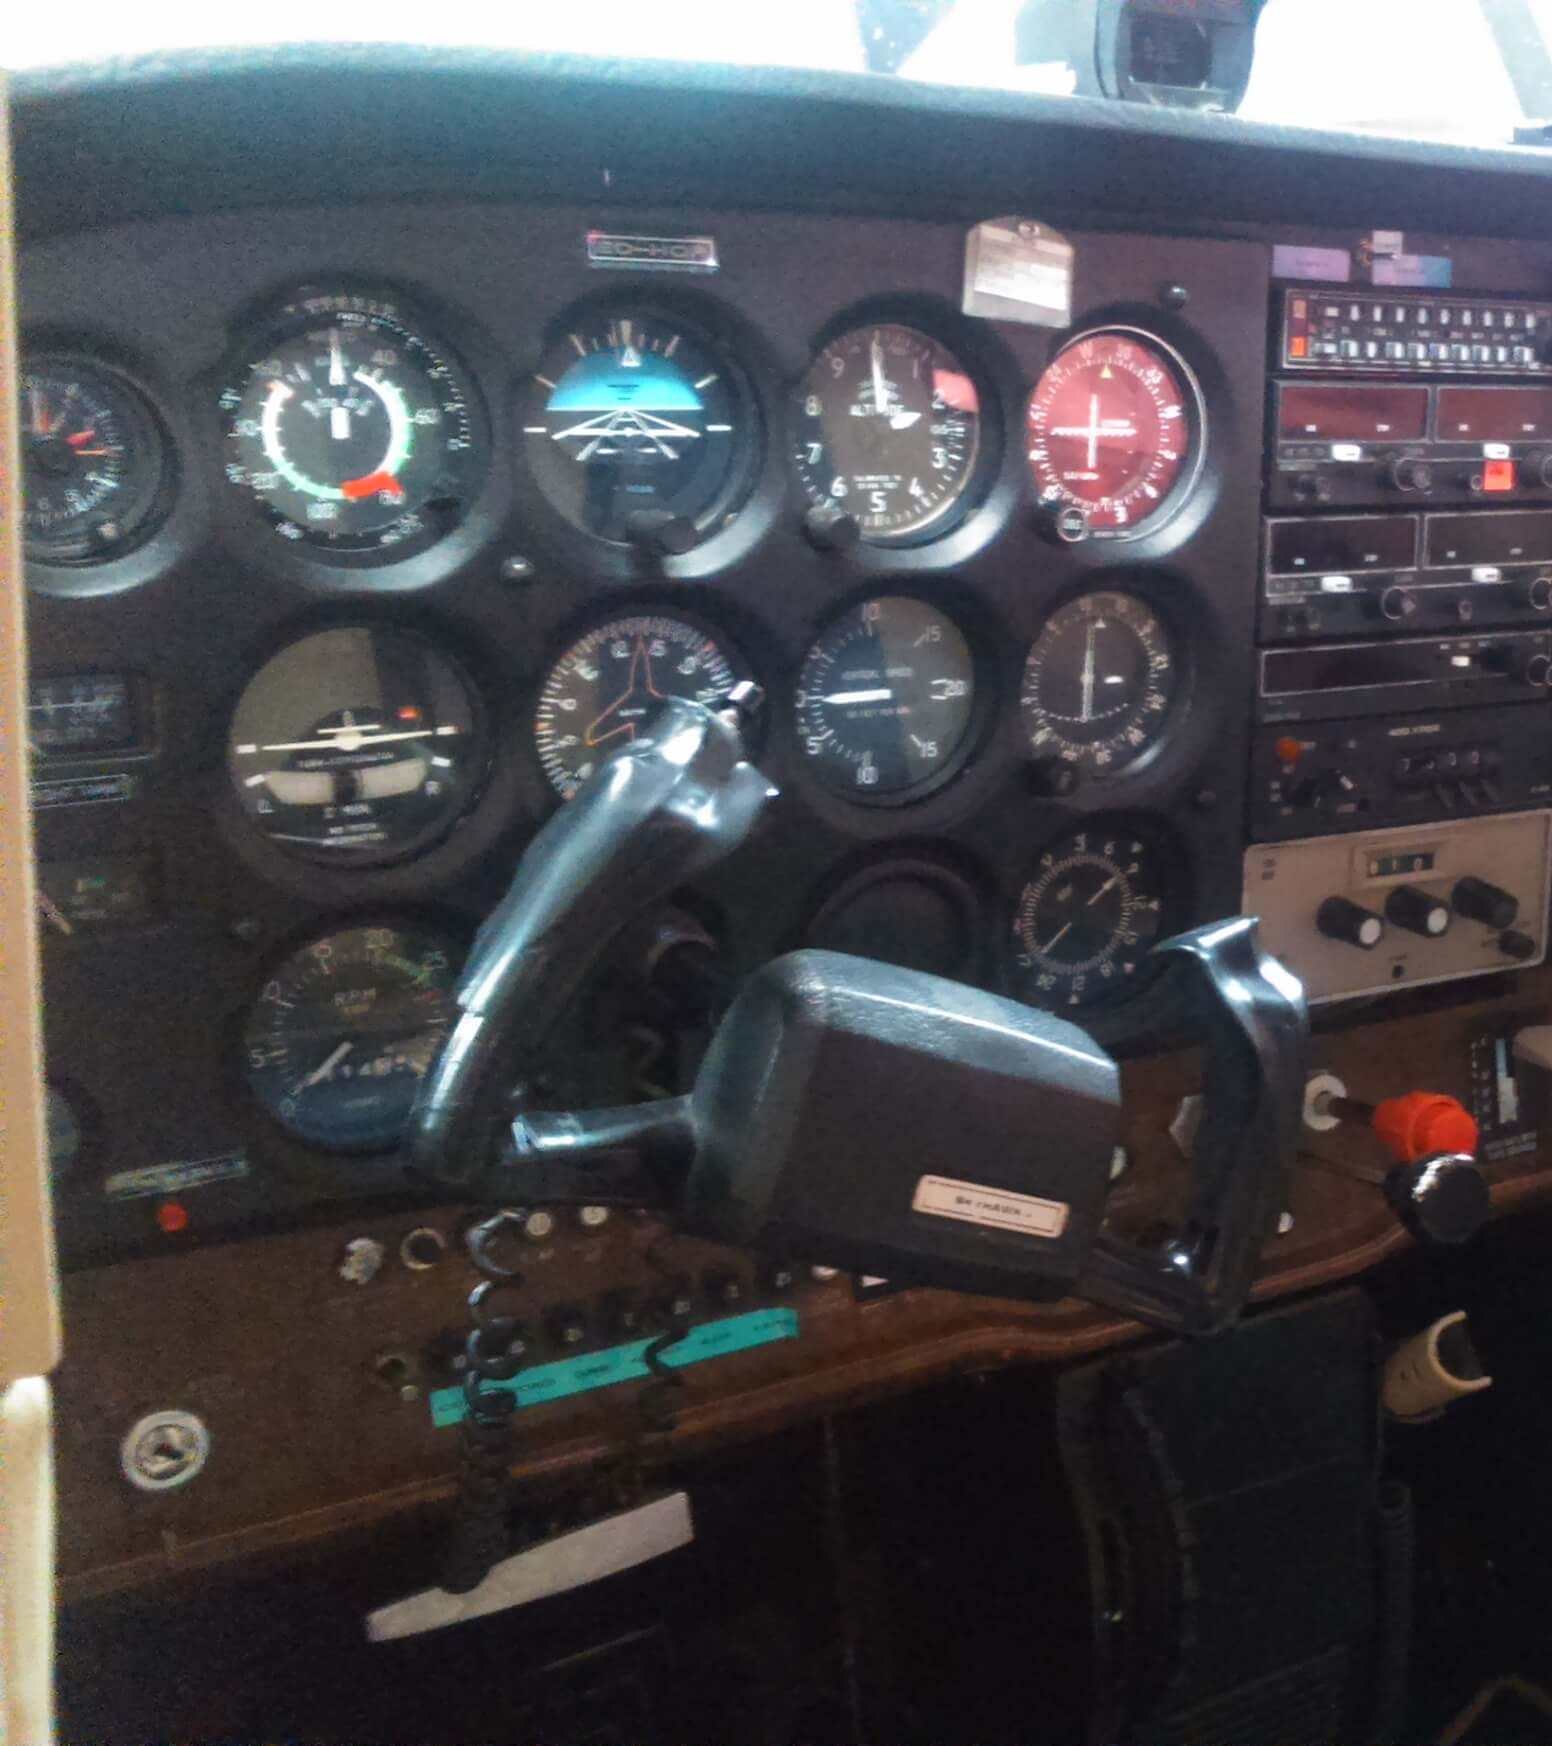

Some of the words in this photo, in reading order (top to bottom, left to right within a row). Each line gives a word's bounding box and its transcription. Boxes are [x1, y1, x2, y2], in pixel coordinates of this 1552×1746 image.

[831, 357, 845, 378] 9
[804, 395, 820, 416] 8
[931, 388, 945, 409] 2
[806, 443, 822, 464] 7
[932, 448, 947, 469] 3
[831, 475, 848, 497] 6
[908, 477, 924, 497] 4
[870, 492, 887, 513] 5
[926, 625, 943, 642] 15
[806, 736, 823, 755] 5
[920, 741, 939, 758] 15
